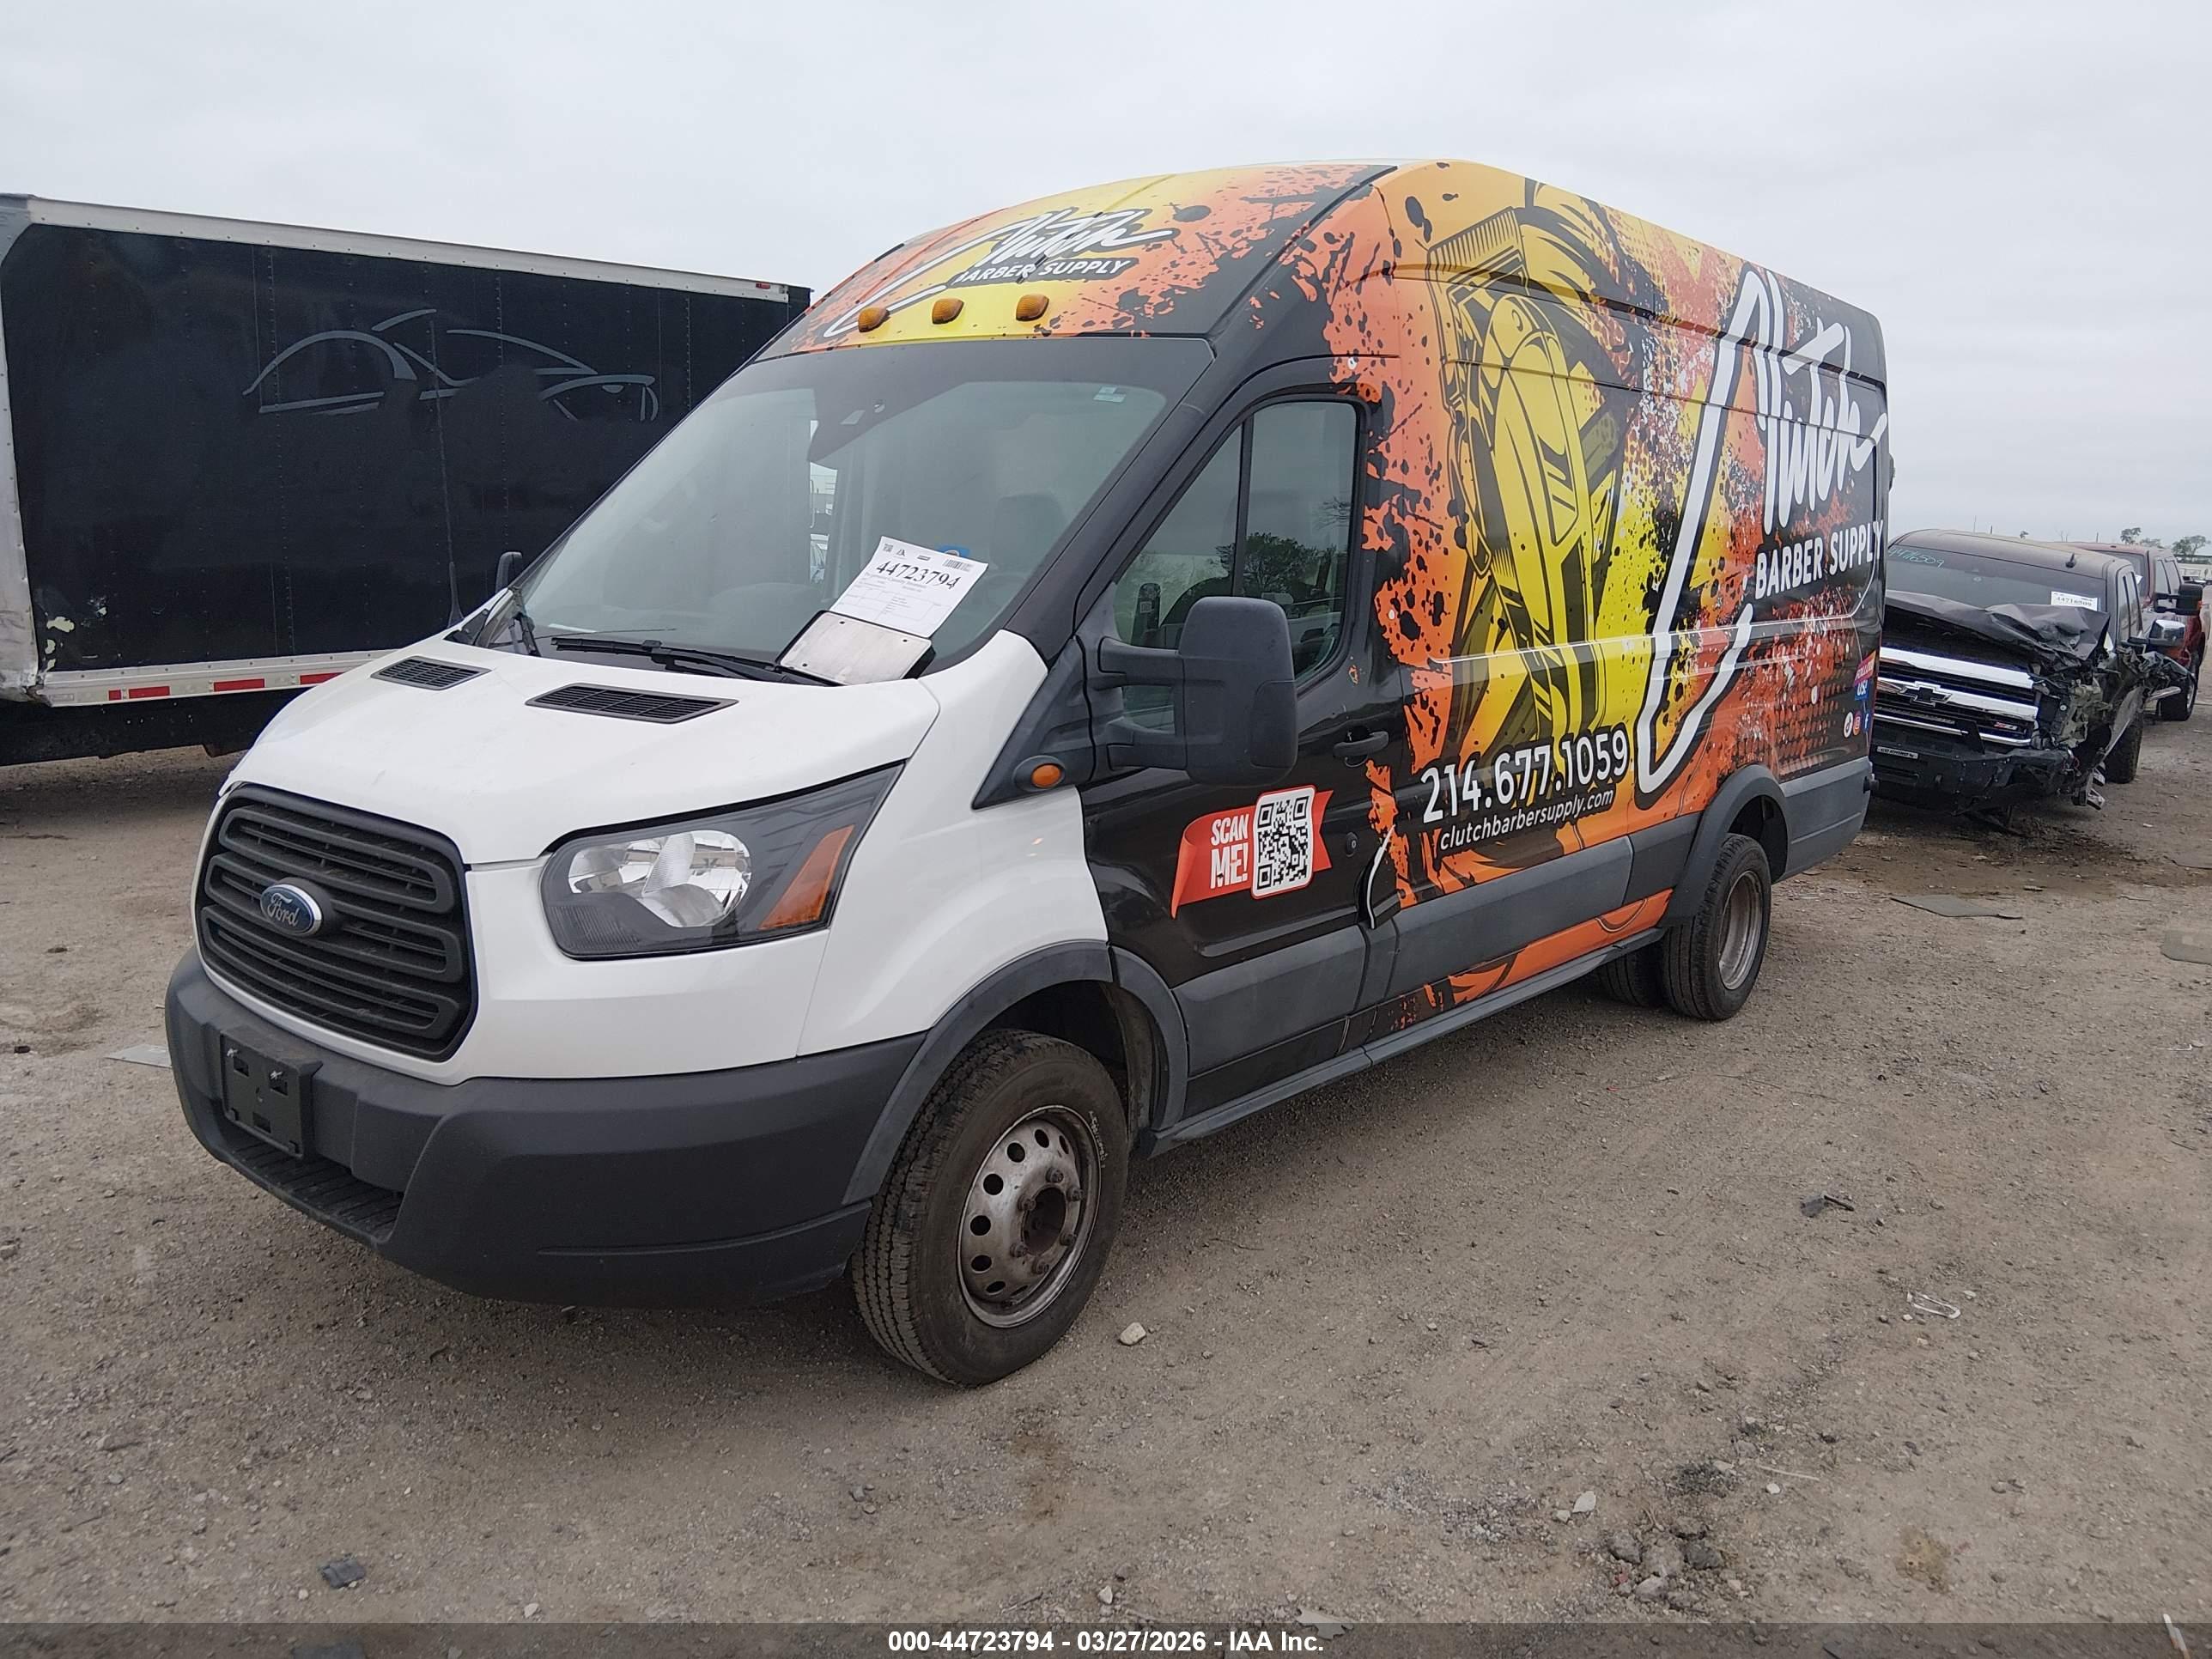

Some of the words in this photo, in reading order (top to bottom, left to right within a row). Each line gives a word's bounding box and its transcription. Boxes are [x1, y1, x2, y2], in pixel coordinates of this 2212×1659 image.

[1038, 259, 1132, 276] SUPPLY
[876, 560, 962, 590] 44723794
[1755, 537, 1824, 599] BARBER
[1829, 519, 1884, 575] SUPPLY
[1420, 730, 1628, 823] 214.677.1059
[1211, 814, 1249, 846] SCAN
[1440, 789, 1614, 850] clutchbarbersupply.com
[1210, 842, 1249, 889] ME!
[267, 892, 301, 927] Ford
